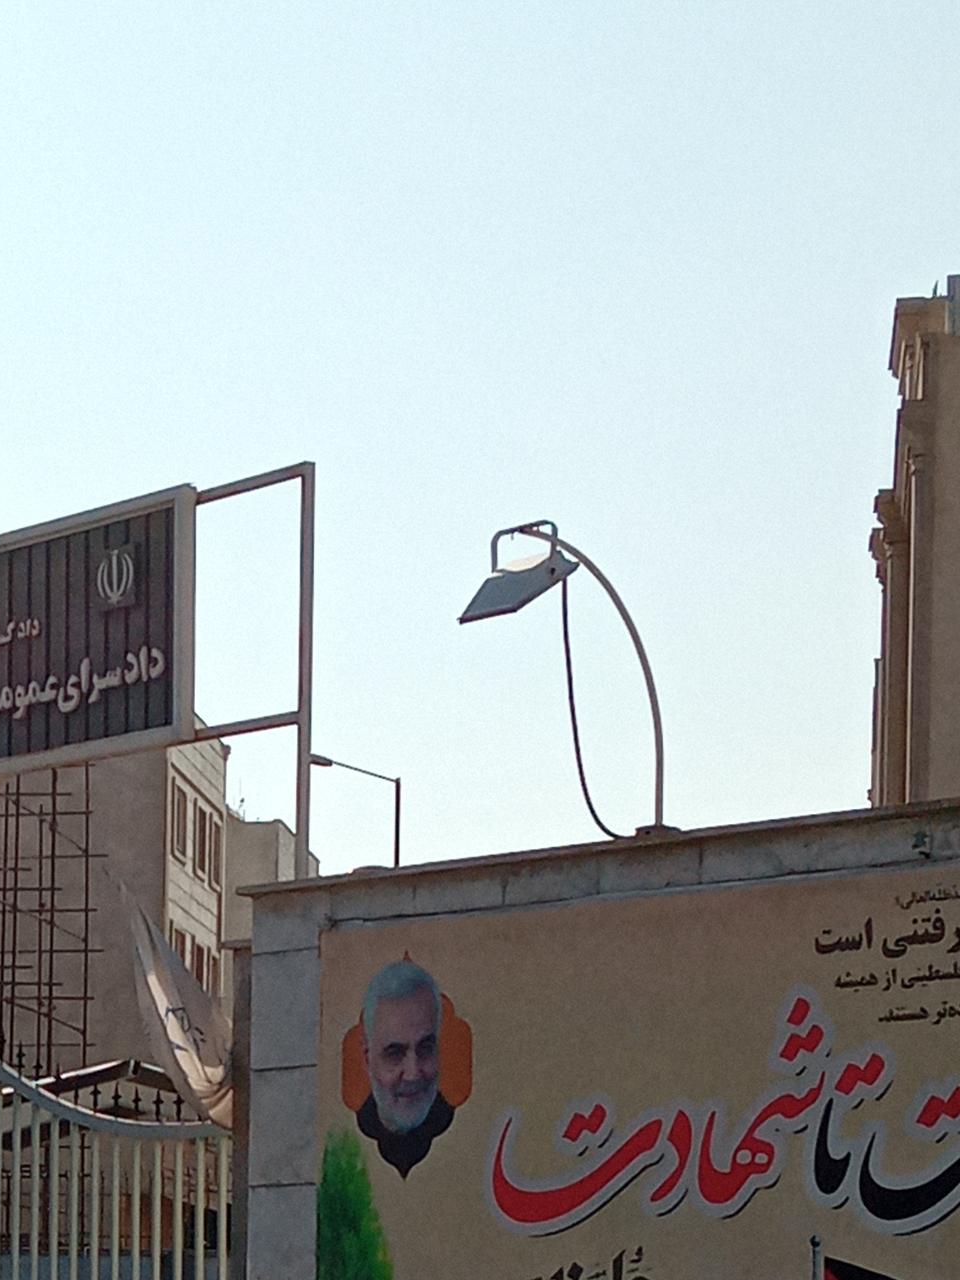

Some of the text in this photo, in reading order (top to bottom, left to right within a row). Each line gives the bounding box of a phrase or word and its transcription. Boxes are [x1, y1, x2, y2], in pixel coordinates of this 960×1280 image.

[814, 916, 874, 954] است
[835, 972, 878, 993] همیشه
[882, 968, 897, 991] از
[492, 997, 826, 1225] شهادت
